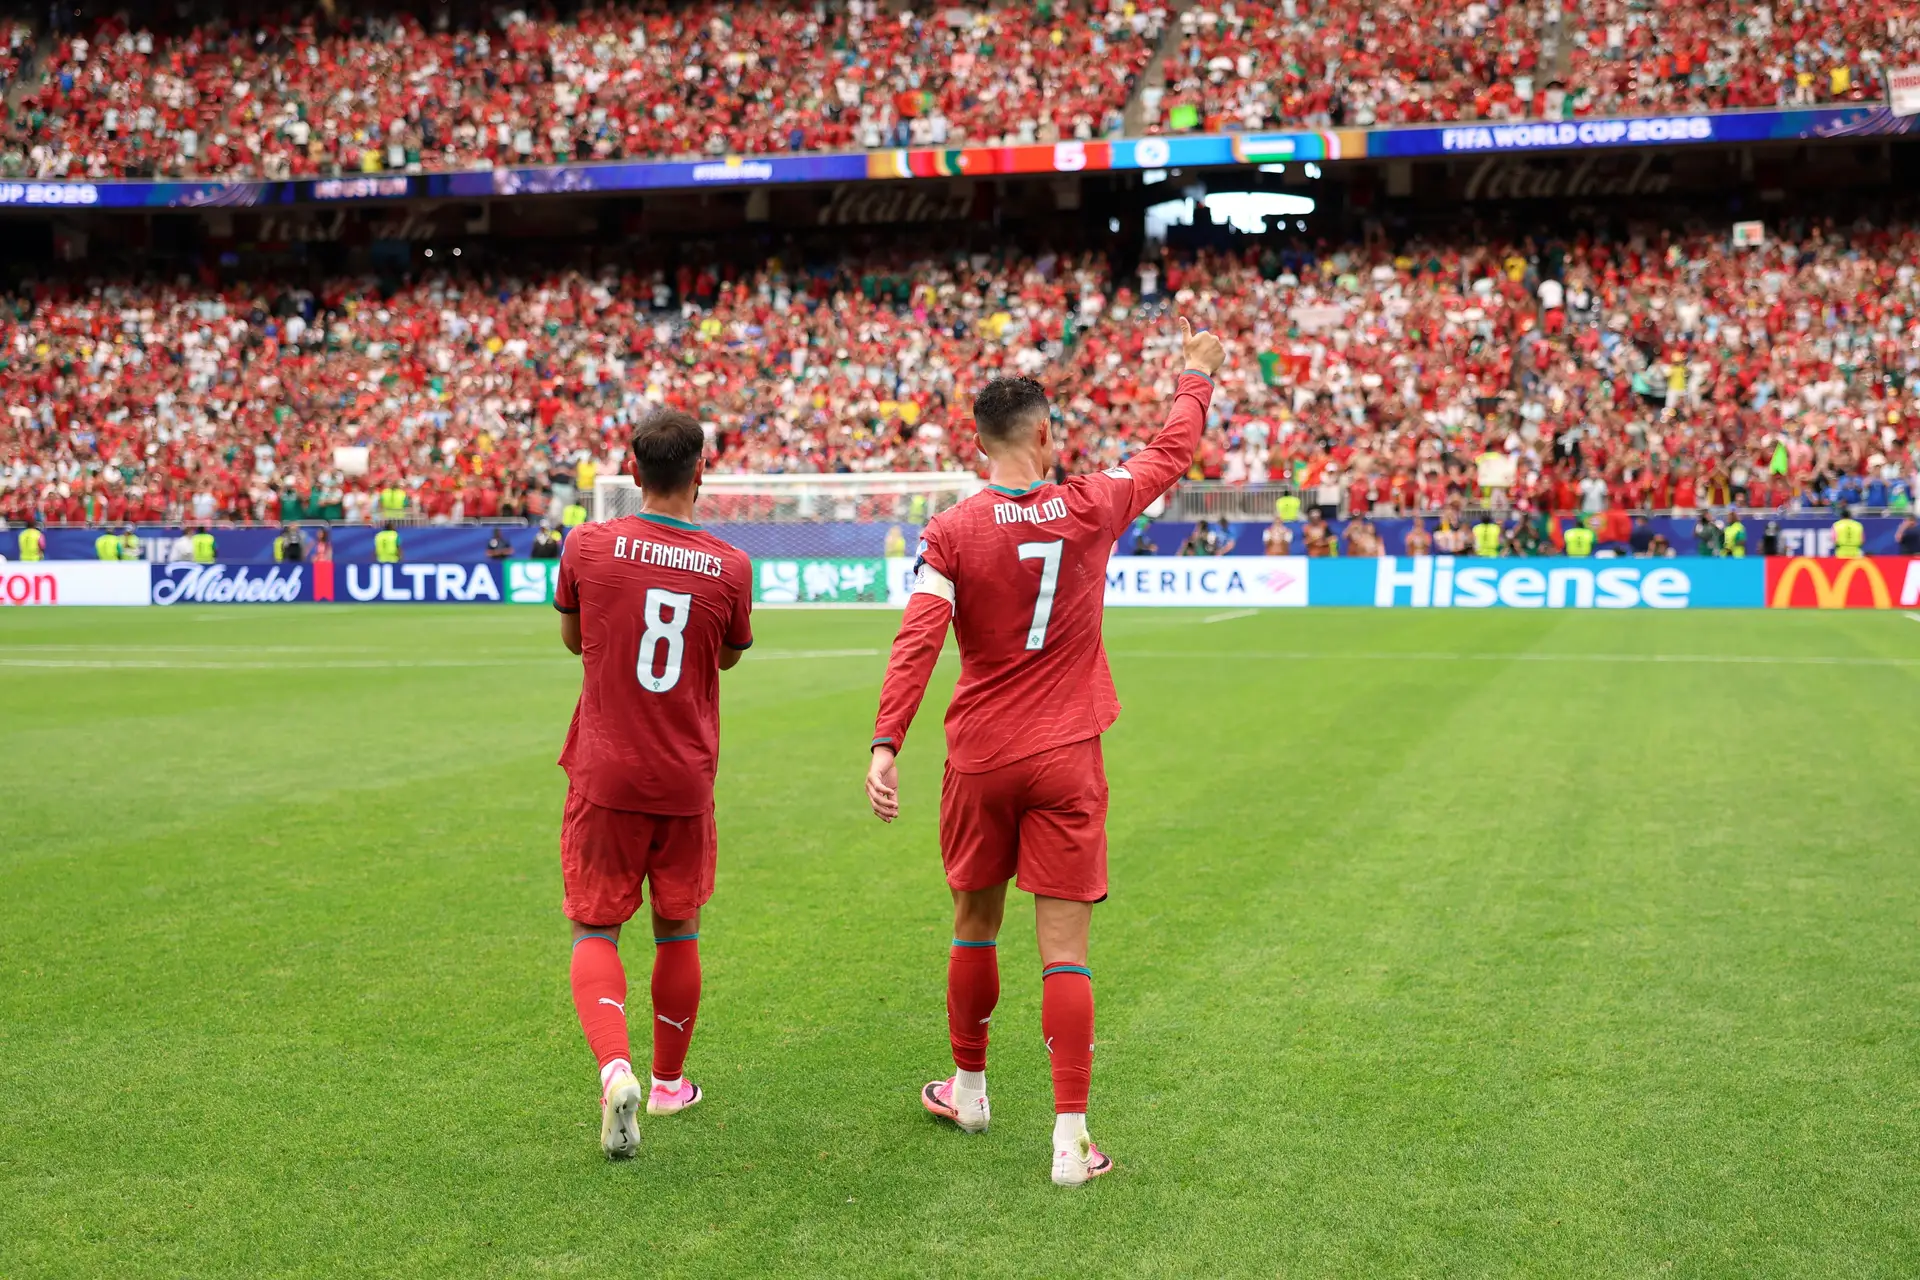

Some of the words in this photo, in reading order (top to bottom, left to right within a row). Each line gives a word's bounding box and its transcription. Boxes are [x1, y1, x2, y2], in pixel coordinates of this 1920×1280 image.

[1443, 128, 1492, 149] FIFA
[1494, 123, 1577, 147] WORLD
[1578, 120, 1626, 143] CUP
[1627, 117, 1712, 141] 2026
[1053, 141, 1087, 171] 5
[993, 497, 1068, 525] RONALDO
[614, 536, 628, 558] B.
[631, 539, 722, 577] FERNANDES
[1780, 528, 1835, 558] FIF
[0, 572, 57, 604] on
[152, 561, 304, 605] Michelob
[346, 563, 500, 601] ULTRA
[1017, 538, 1064, 650] 7
[1106, 569, 1246, 593] MERICA
[1374, 555, 1691, 608] Hisense
[636, 587, 693, 693] 8
